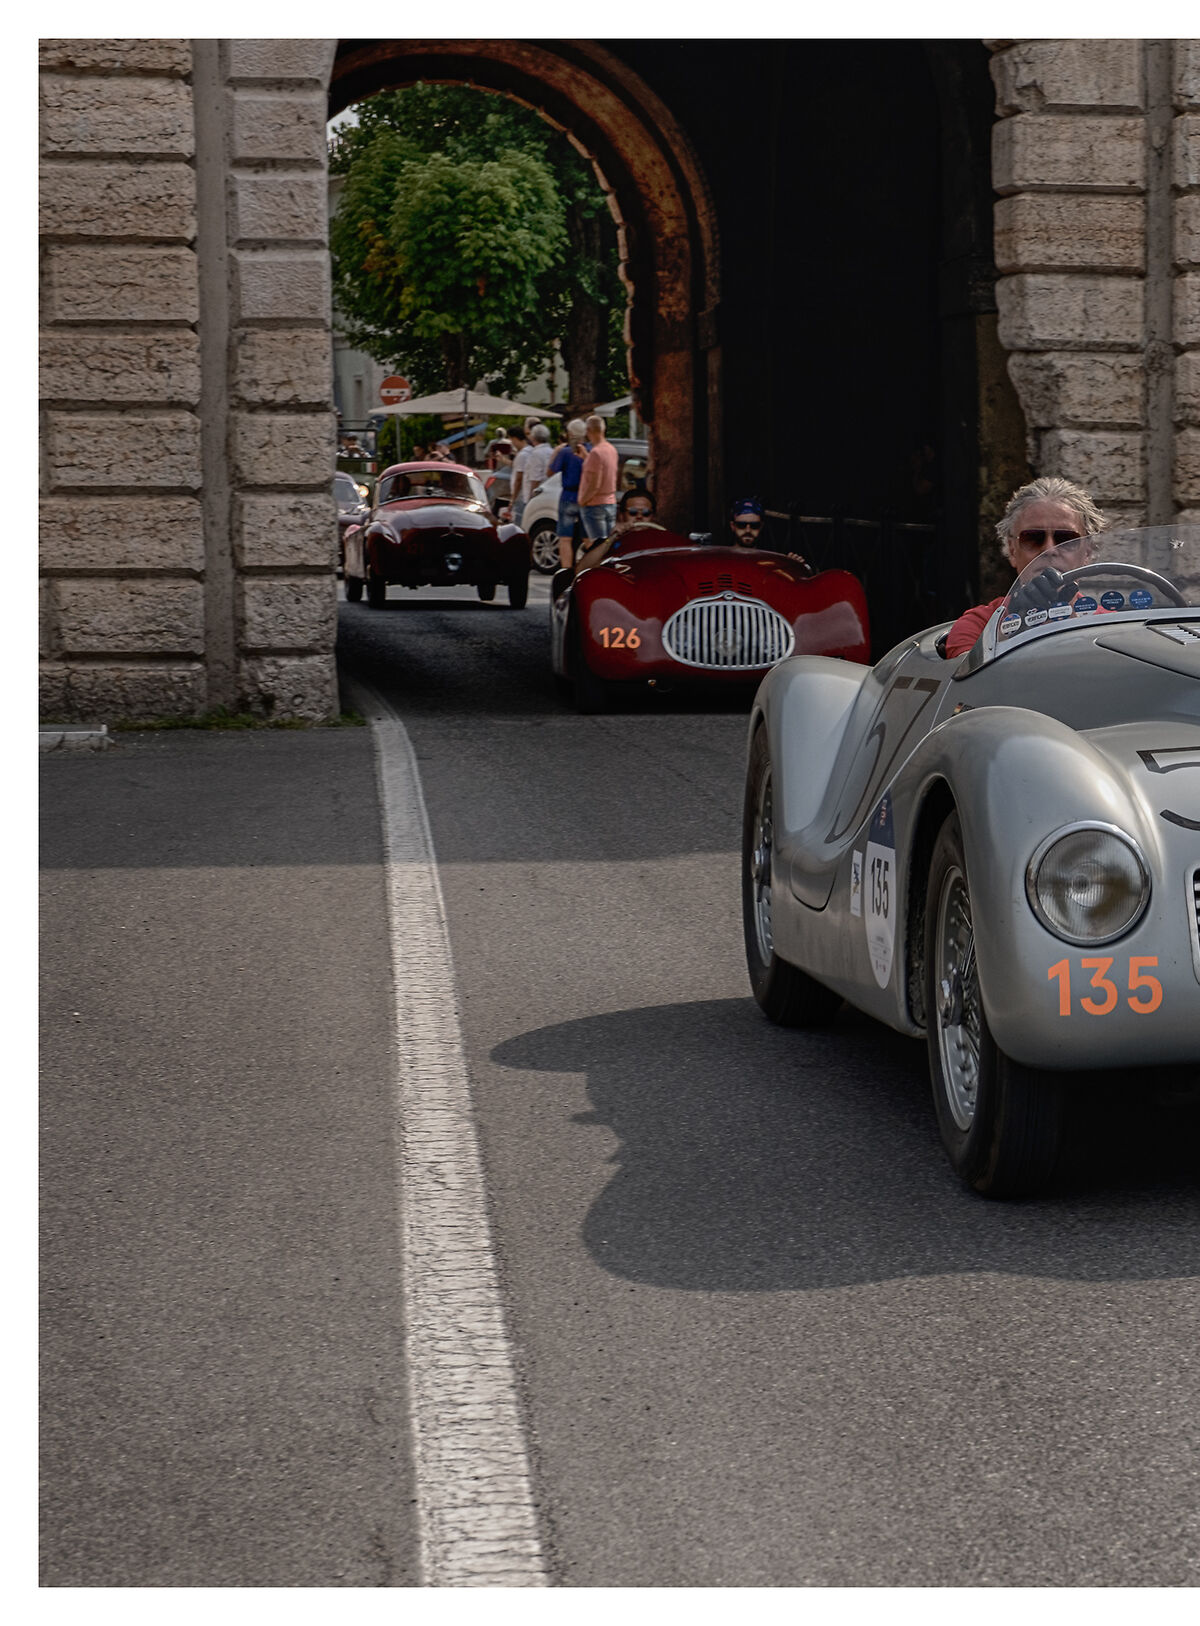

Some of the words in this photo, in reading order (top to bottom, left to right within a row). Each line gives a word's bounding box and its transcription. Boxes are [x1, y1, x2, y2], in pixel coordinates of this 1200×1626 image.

[599, 627, 641, 649] 126
[870, 857, 890, 919] 135
[1047, 956, 1163, 1016] 135
